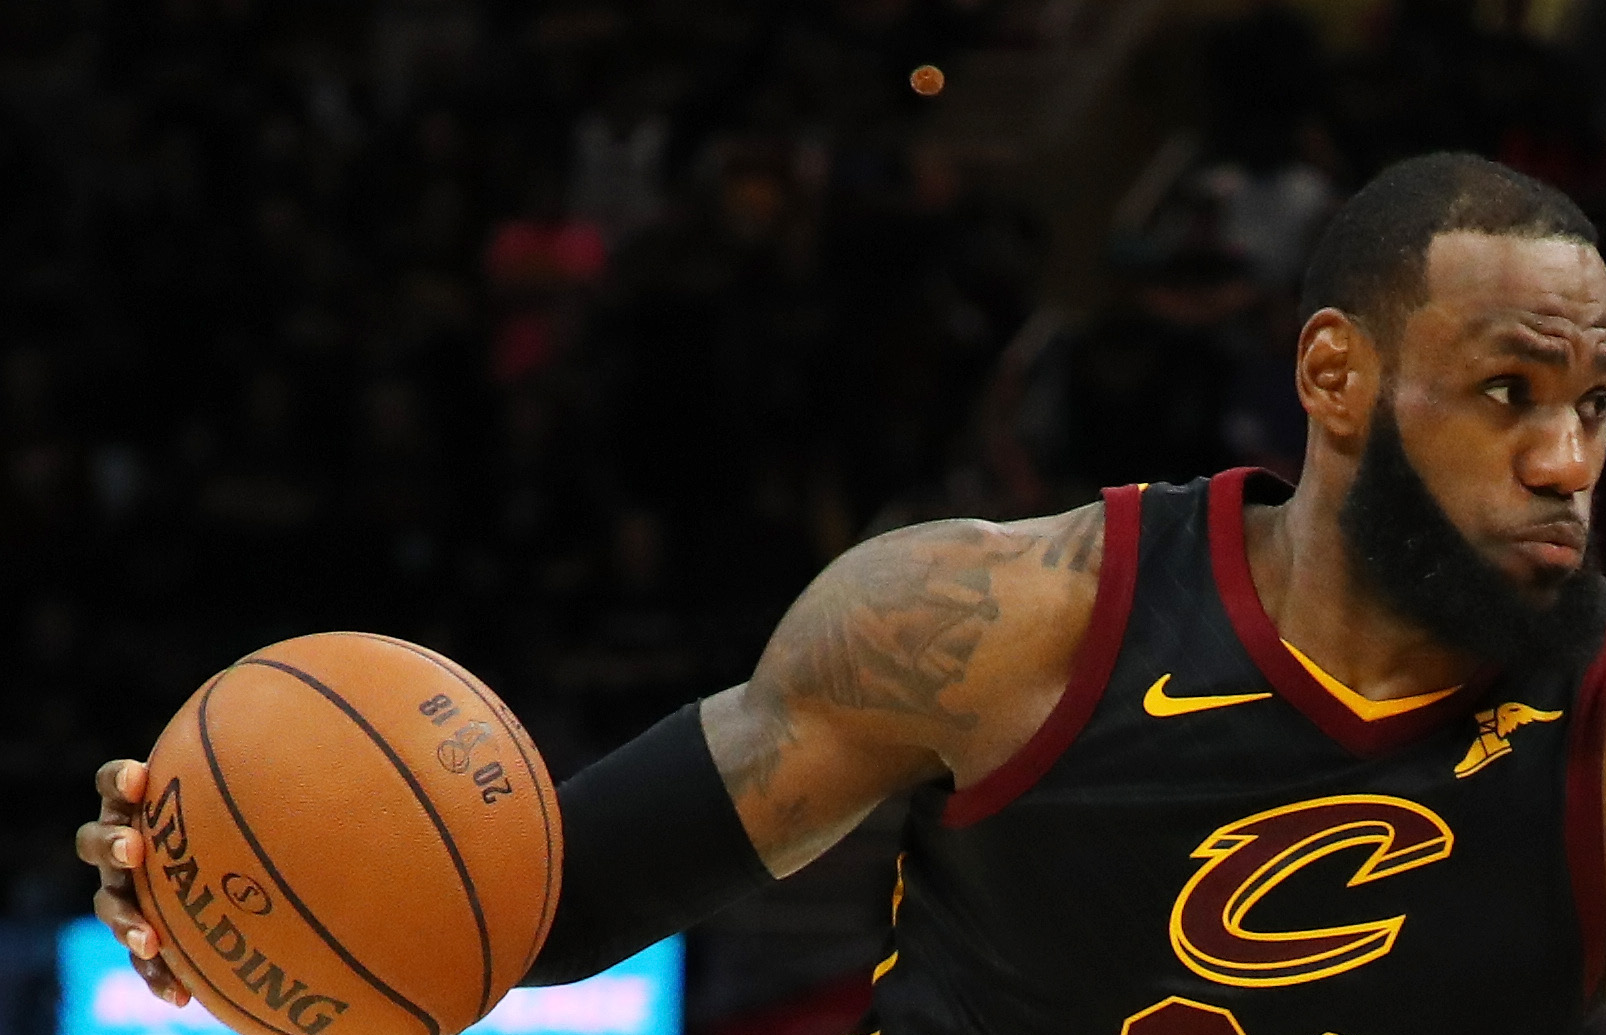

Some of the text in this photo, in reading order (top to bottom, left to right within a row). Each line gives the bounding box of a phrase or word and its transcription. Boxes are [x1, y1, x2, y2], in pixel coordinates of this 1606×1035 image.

[420, 693, 460, 726] 18
[473, 762, 512, 805] 20
[145, 777, 349, 1035] SPALDING
[1169, 794, 1454, 988] C
